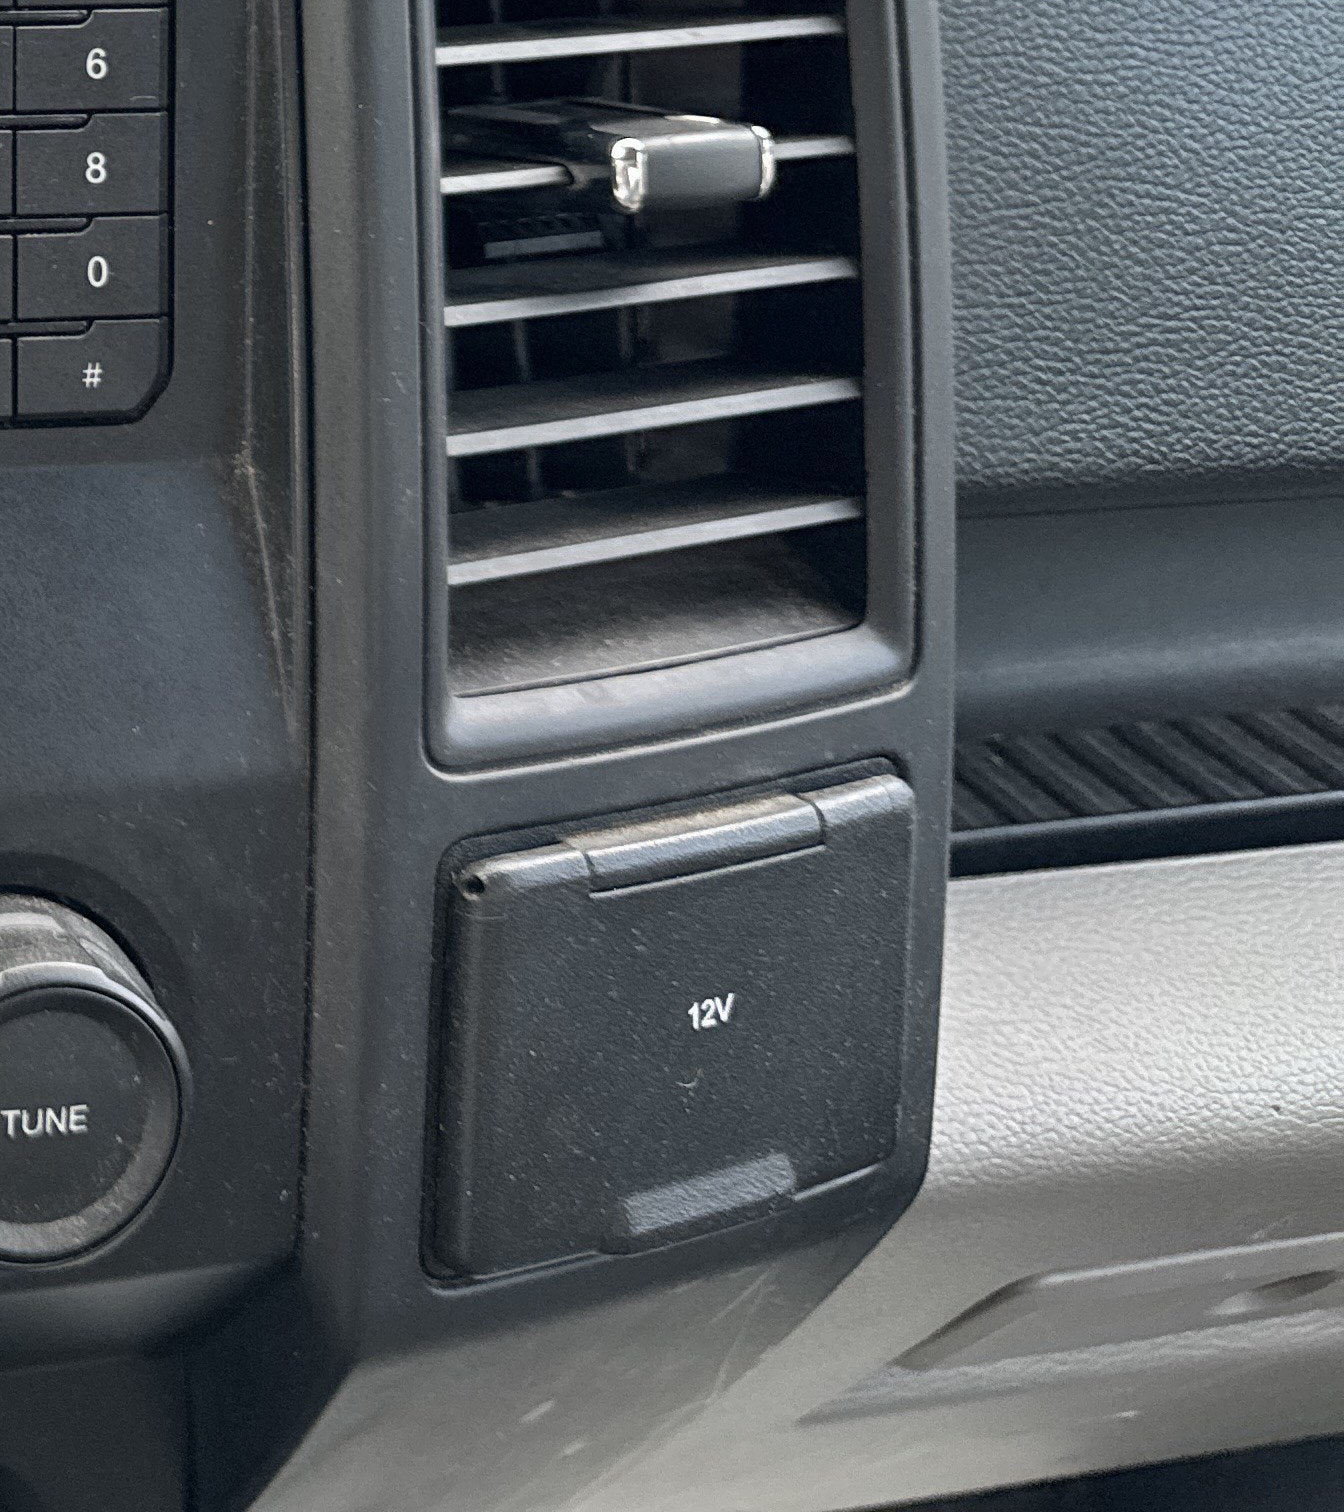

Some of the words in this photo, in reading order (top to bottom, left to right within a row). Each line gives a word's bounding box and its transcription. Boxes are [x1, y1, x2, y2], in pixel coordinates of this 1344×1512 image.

[86, 47, 108, 80] 6
[85, 151, 107, 184] 8
[87, 255, 109, 288] 0
[687, 992, 736, 1031] 12V
[0, 1104, 88, 1137] TUNE
